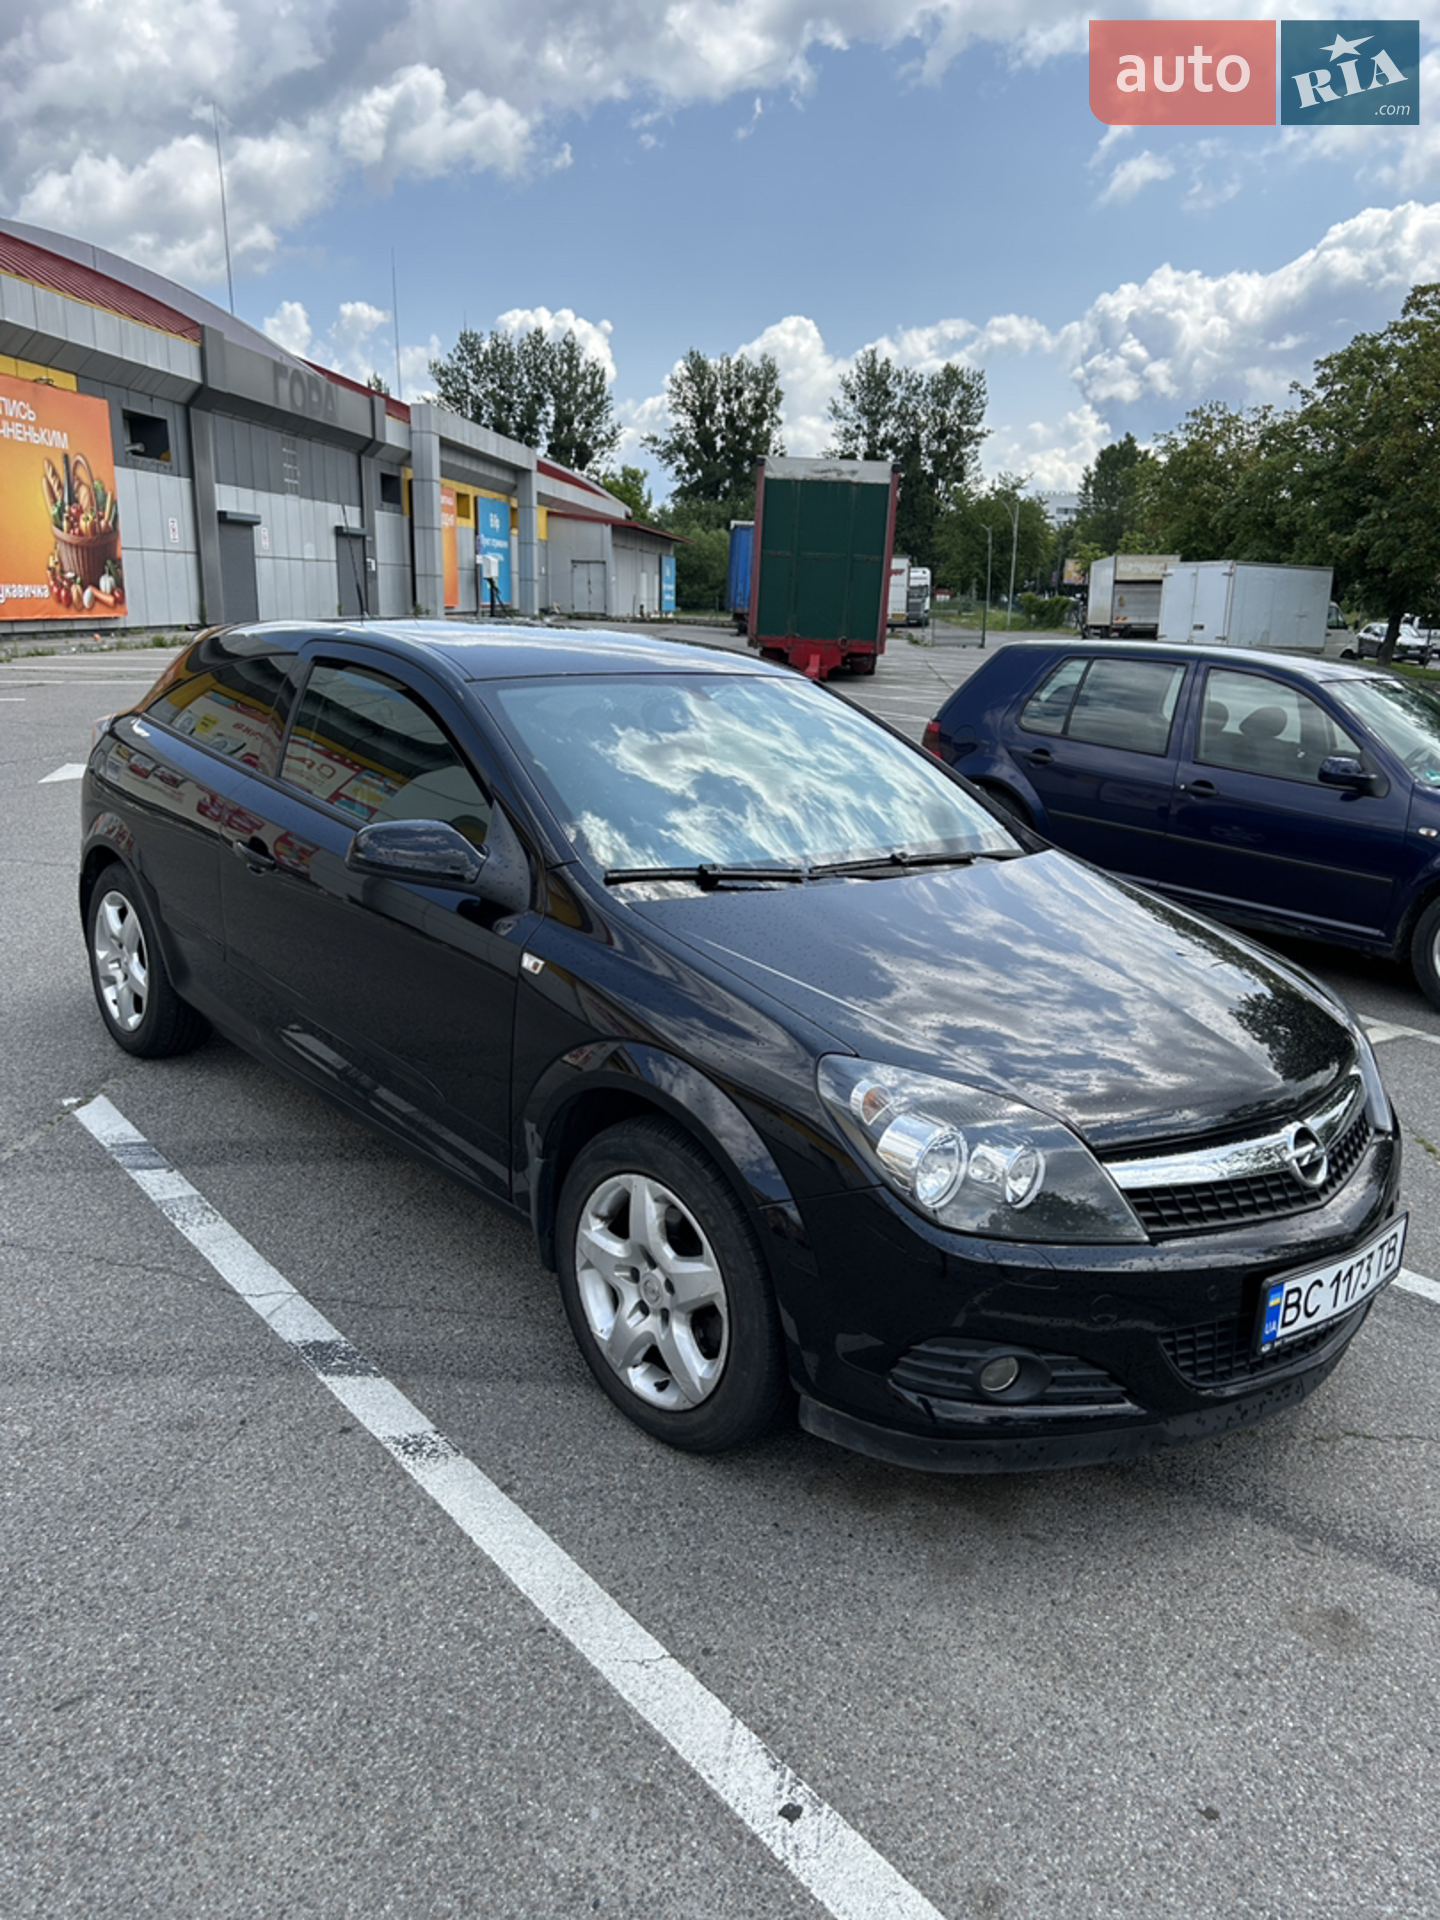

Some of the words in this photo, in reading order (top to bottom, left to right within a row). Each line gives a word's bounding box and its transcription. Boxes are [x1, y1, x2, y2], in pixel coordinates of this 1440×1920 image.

[1280, 1279, 1323, 1328] BC
[1330, 1251, 1374, 1308] 1173
[1376, 1232, 1398, 1278] TB
